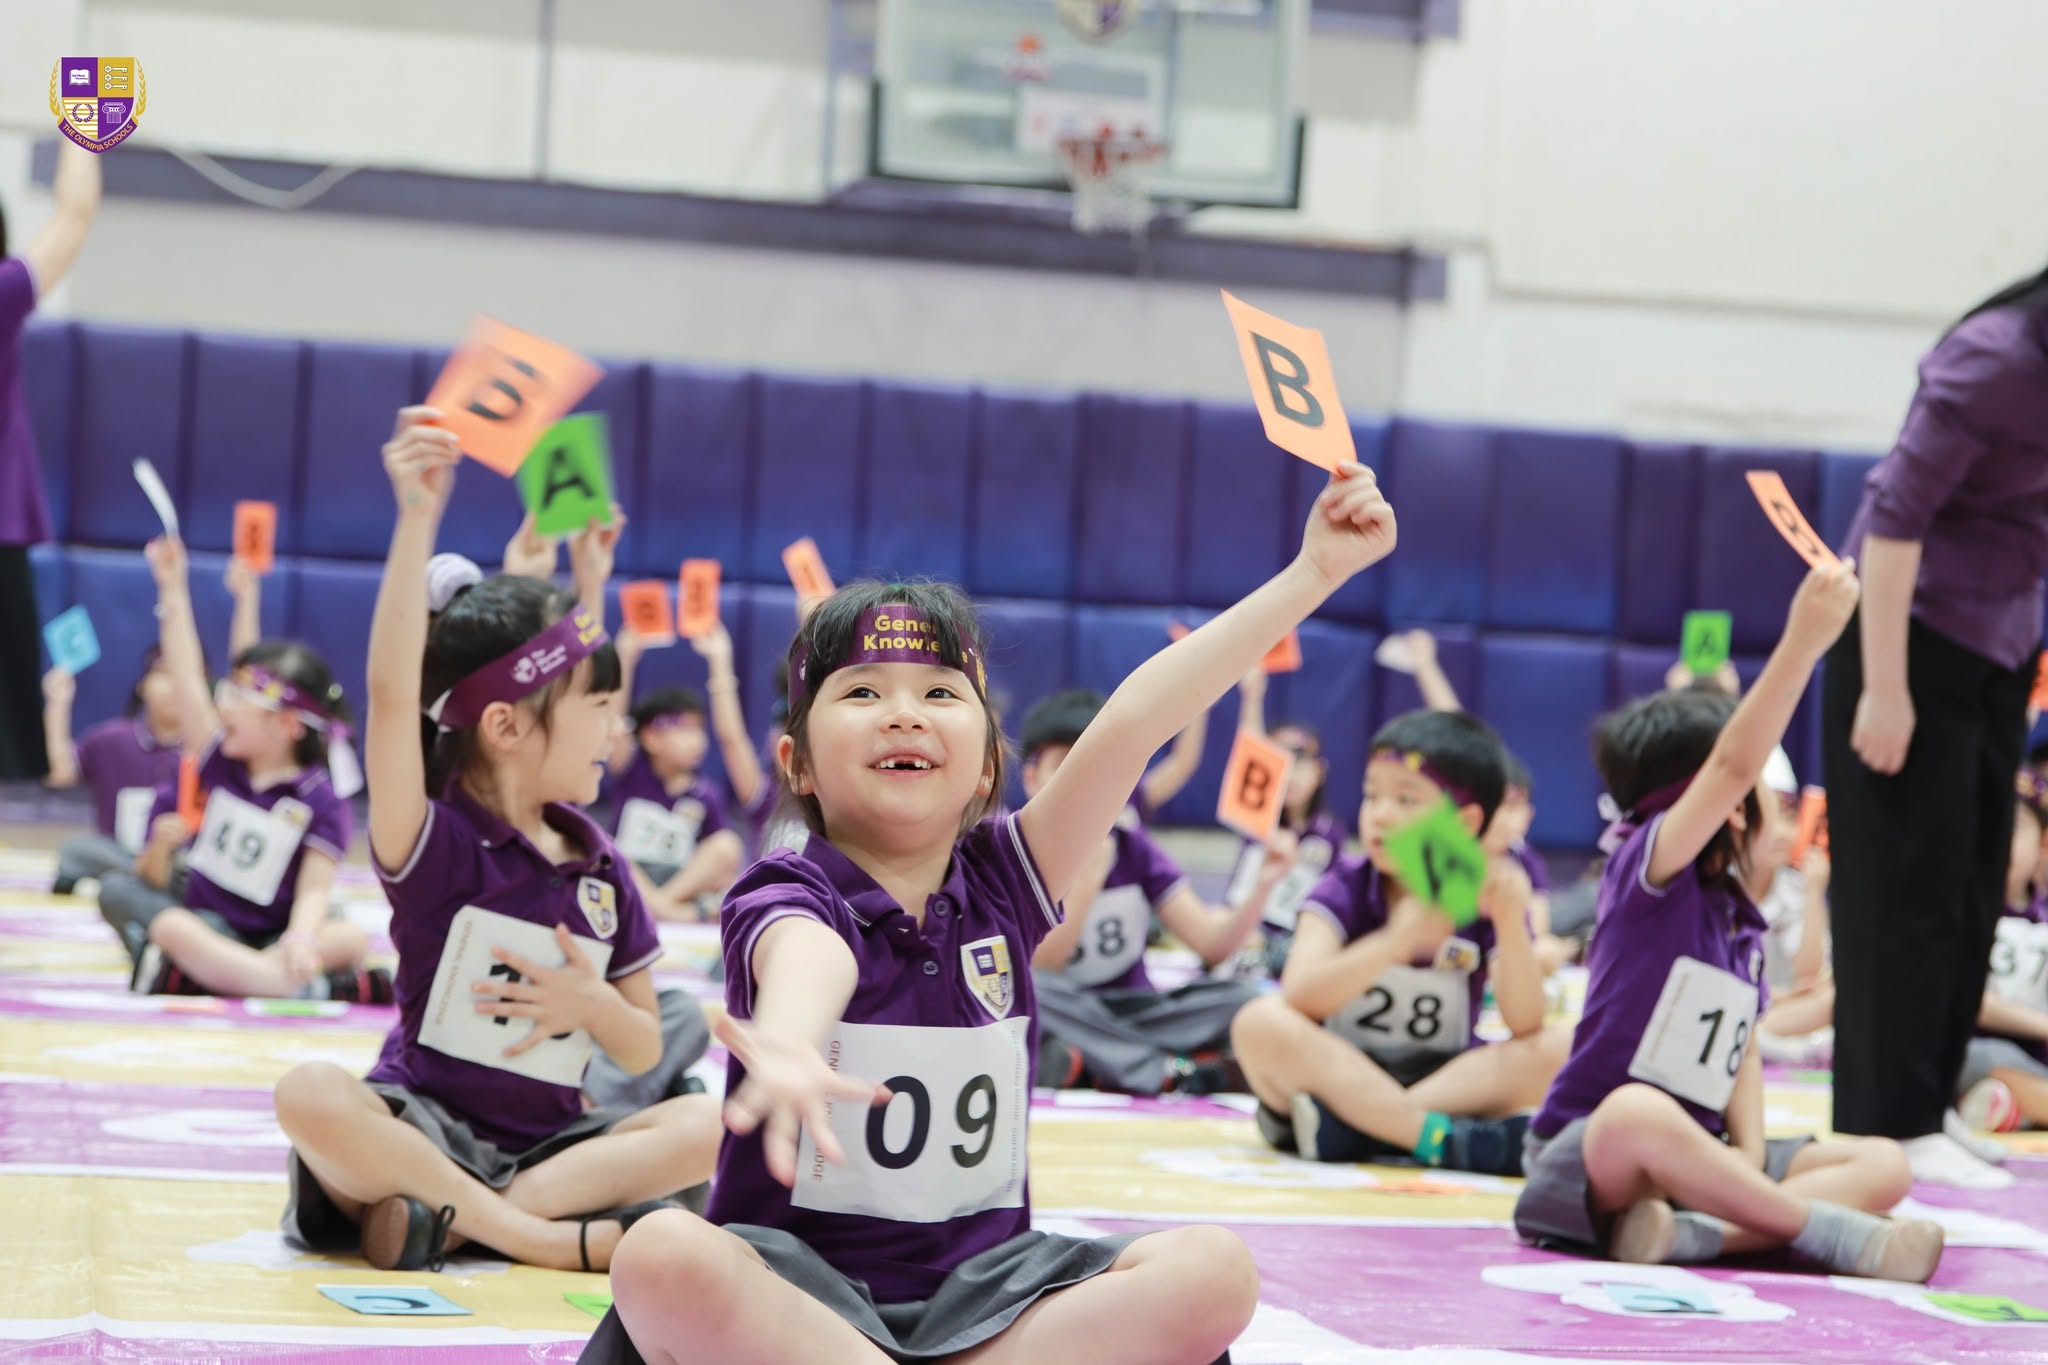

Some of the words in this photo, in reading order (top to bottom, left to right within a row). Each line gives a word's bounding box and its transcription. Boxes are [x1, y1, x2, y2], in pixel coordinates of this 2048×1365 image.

[1249, 330, 1324, 428] B
[540, 447, 597, 511] A
[1239, 760, 1271, 811] B
[1356, 985, 1441, 1040] 28
[1698, 1008, 1748, 1077] 18
[865, 1074, 997, 1169] 09
